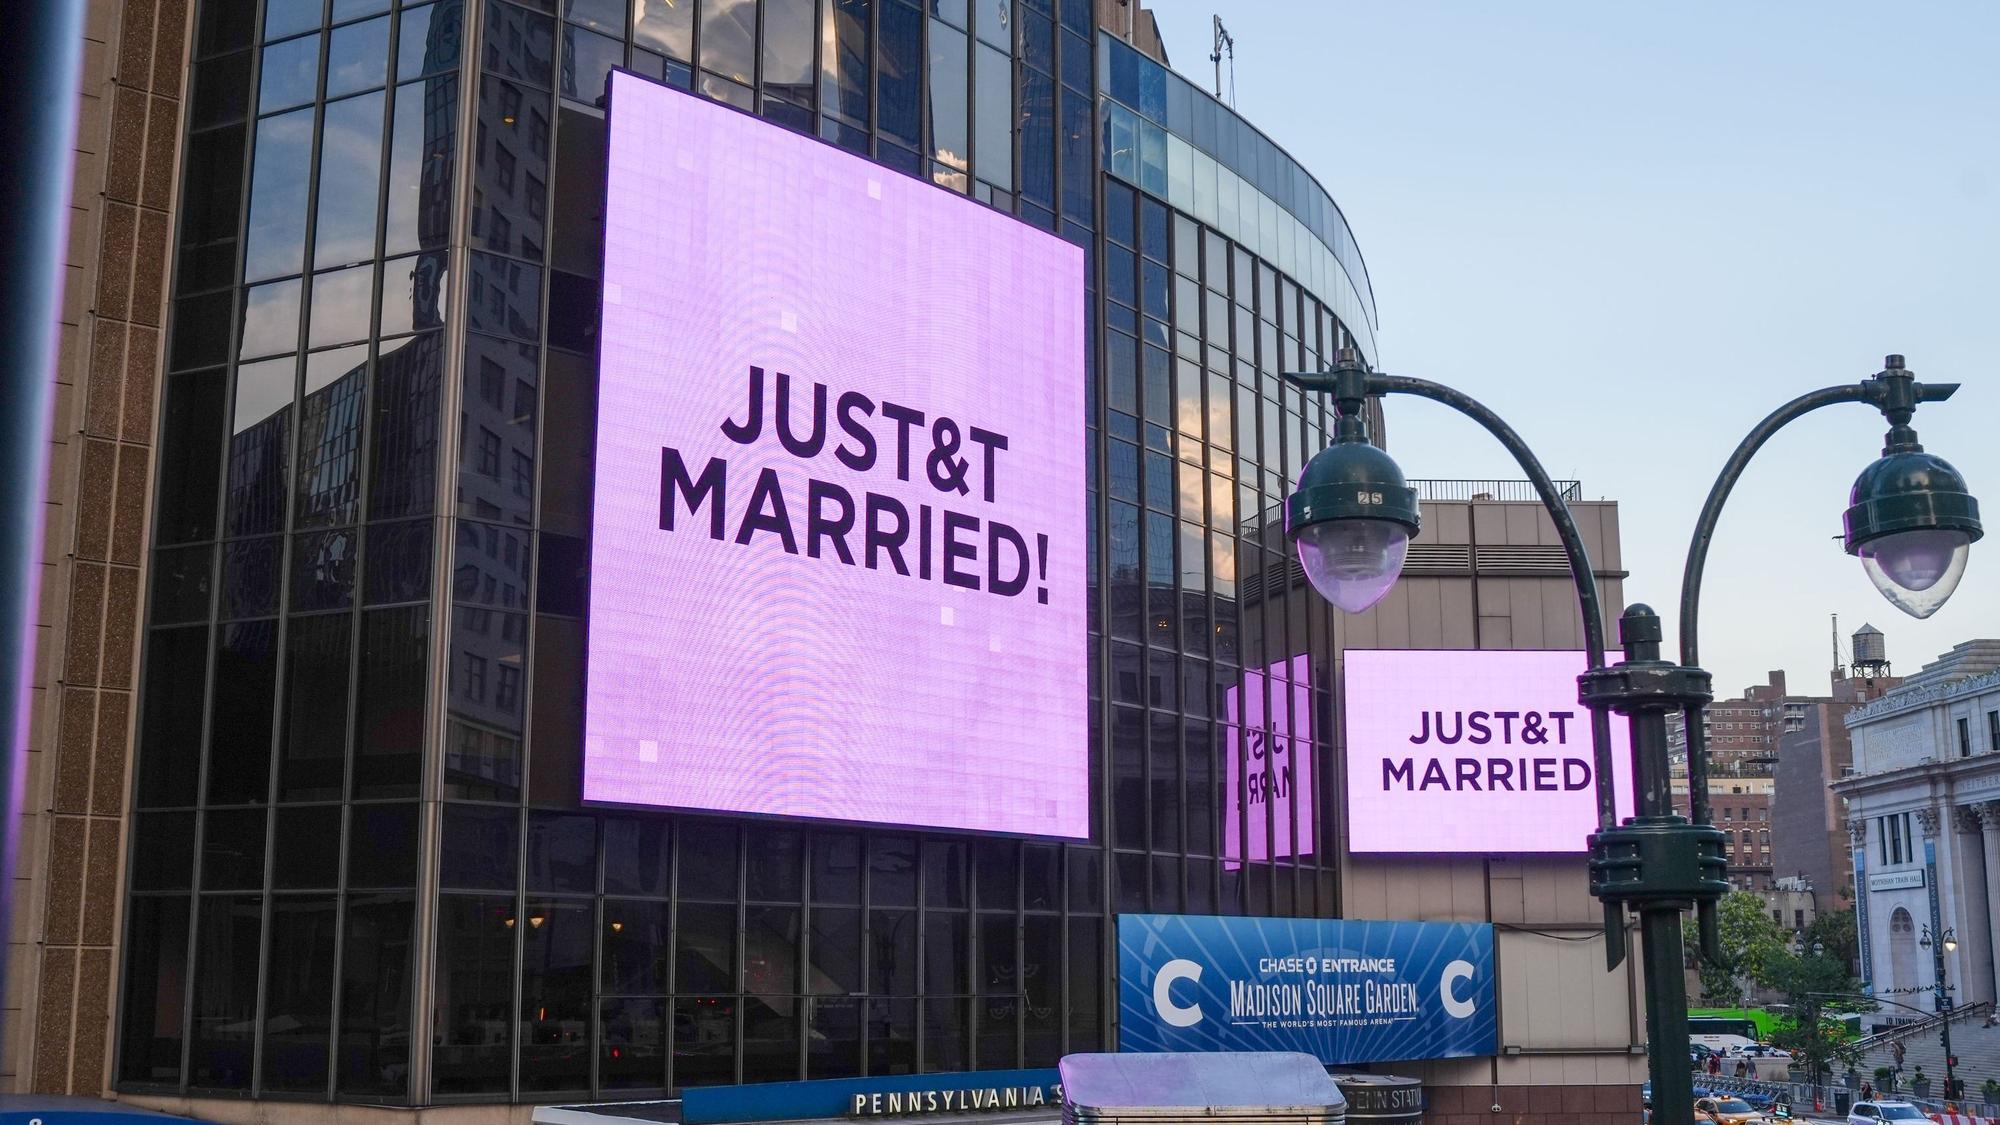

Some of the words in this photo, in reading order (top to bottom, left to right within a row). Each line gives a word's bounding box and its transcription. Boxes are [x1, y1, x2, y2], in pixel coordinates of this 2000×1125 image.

[720, 365, 1009, 504] JUST&T
[1359, 492, 1381, 505] 25
[659, 446, 1049, 605] MARRIED!
[1409, 710, 1575, 745] JUST&T
[1382, 757, 1592, 792] MARRIED
[1259, 958, 1304, 973] CHASE
[1322, 958, 1395, 973] ENTRANCE
[1153, 958, 1204, 1028] C
[1230, 980, 1301, 1017] MADISON
[1306, 979, 1361, 1018] SQUARE
[1440, 959, 1476, 1019] C
[1262, 1021, 1277, 1029] THE
[1280, 1020, 1314, 1028] WORLD'S
[1317, 1019, 1337, 1027] MOST
[1339, 1018, 1368, 1027] FAMOUS
[855, 1086, 1045, 1115] PENNSYLVANIA
